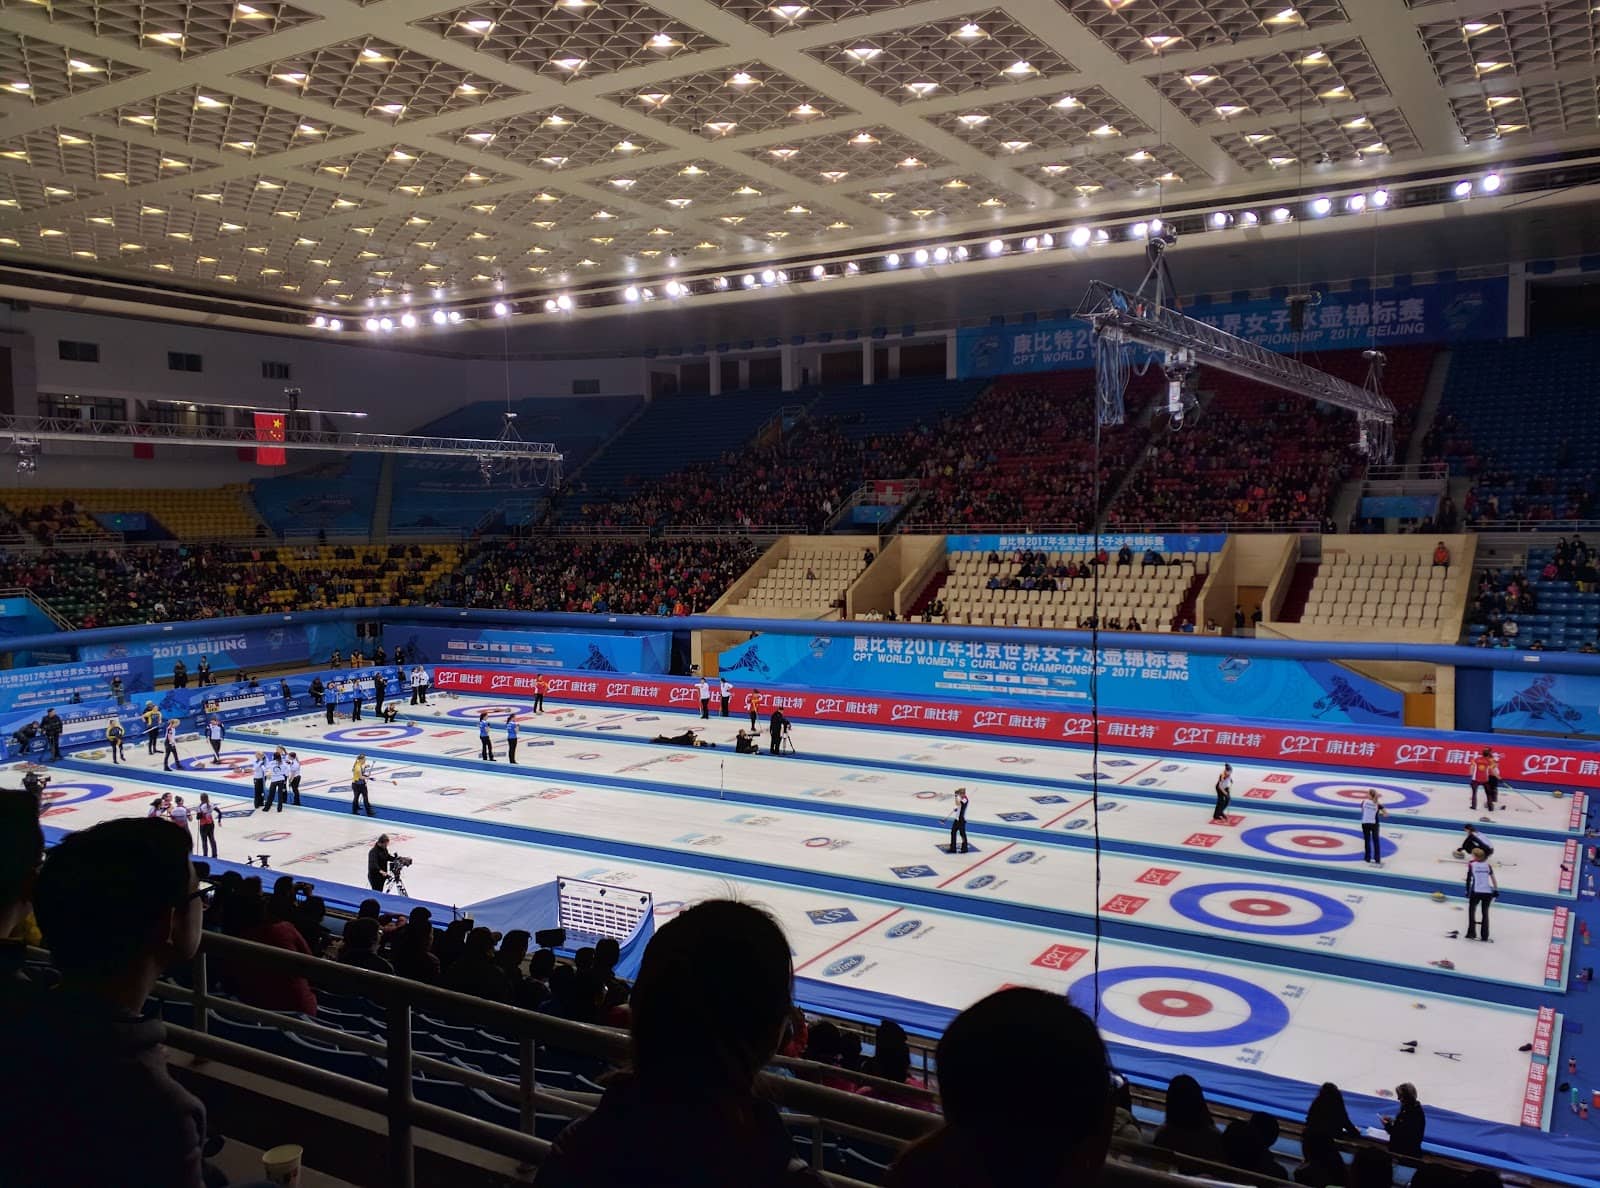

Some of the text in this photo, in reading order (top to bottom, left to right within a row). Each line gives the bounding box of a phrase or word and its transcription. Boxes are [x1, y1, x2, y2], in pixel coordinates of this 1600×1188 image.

[1042, 351, 1085, 363] WORLD
[1330, 328, 1360, 341] 2017
[1366, 322, 1425, 337] BEIJING
[152, 645, 182, 659] 2017
[187, 639, 247, 655] BEIJING
[853, 652, 1189, 681] CPT WORLD WOMEN'S CURLING CHAMPIONSHIP 2017 BEIJING
[438, 671, 459, 685] CPT
[491, 675, 513, 689] CPT
[547, 679, 571, 692] CPT
[606, 683, 630, 698] CPT
[669, 687, 699, 703] CPT
[815, 699, 844, 714] CPT
[891, 704, 922, 720] CPT
[973, 711, 1007, 728] CPT
[1107, 722, 1156, 739] 康比特
[1173, 727, 1262, 748] CPT 康比特
[1280, 735, 1377, 757] CPT 康比特
[1395, 744, 1444, 764] CPT
[1522, 754, 1576, 775] CPT
